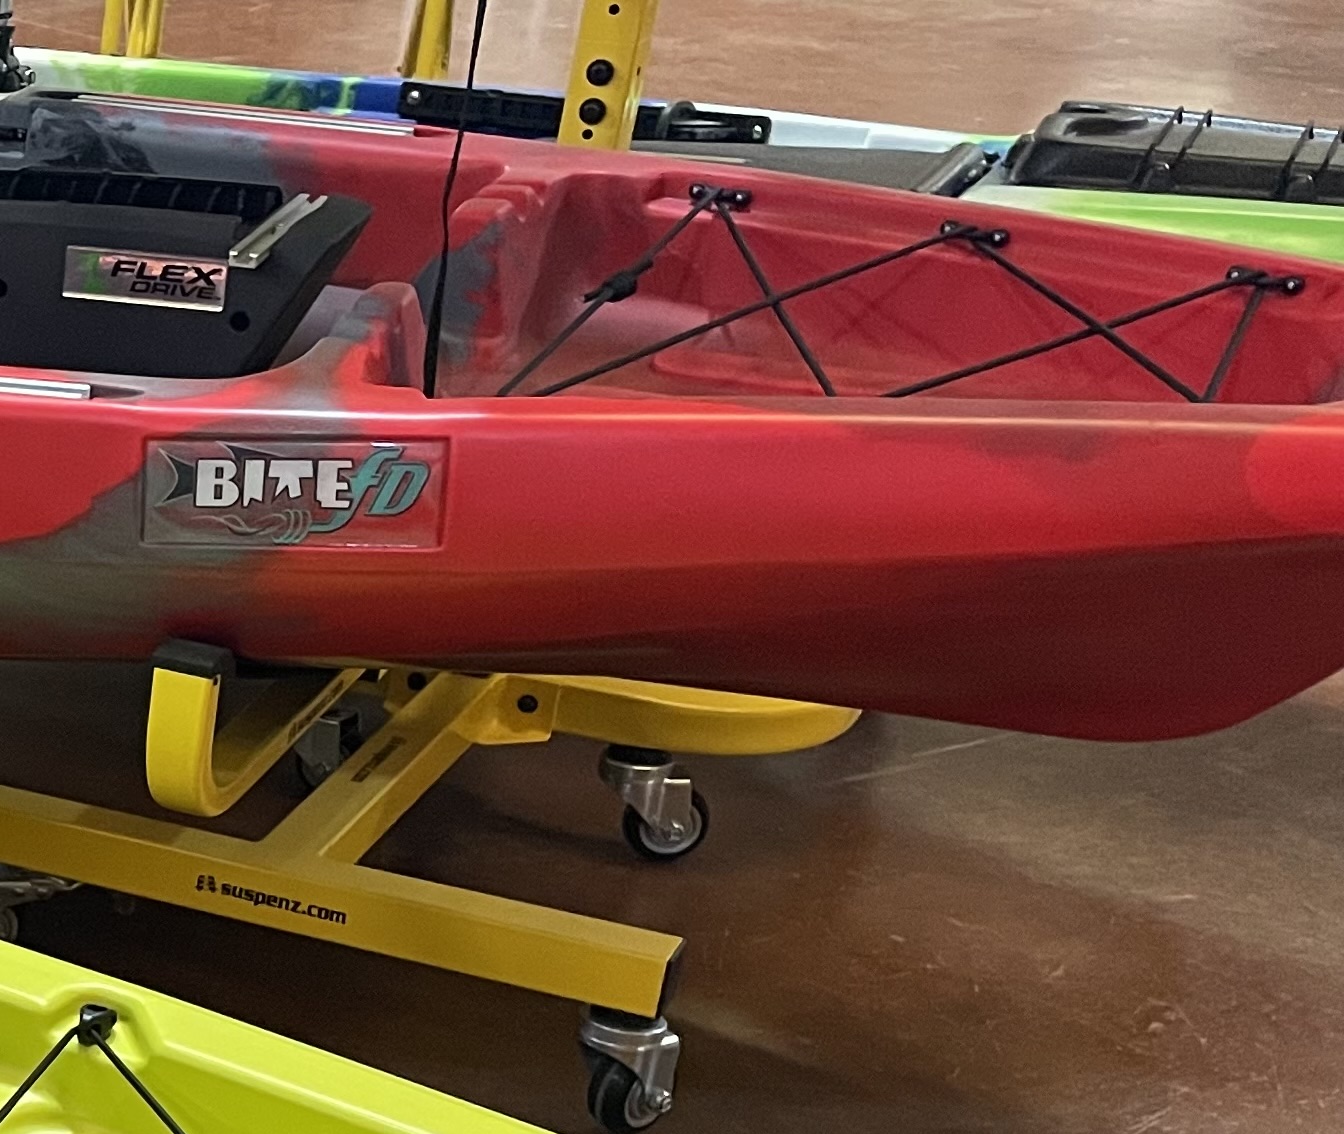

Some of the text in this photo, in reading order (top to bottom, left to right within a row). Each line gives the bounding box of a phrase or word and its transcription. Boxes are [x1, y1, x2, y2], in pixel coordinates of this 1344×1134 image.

[111, 259, 223, 287] FLEX
[130, 280, 218, 299] DRIVE
[220, 882, 348, 925] suspenz.com
